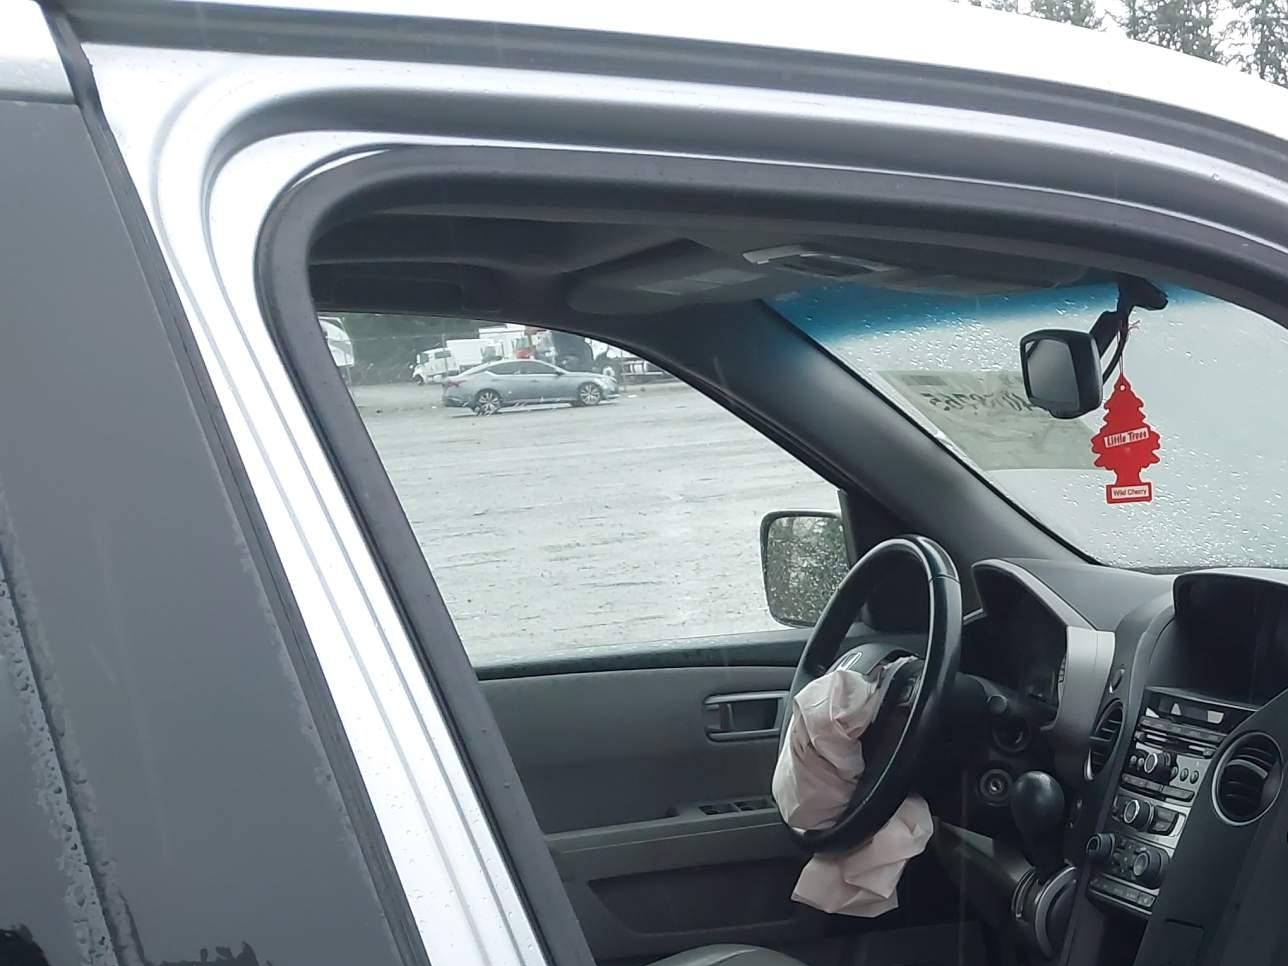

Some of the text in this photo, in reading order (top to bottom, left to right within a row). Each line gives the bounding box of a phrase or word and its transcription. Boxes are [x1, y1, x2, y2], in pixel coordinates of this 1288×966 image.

[1107, 430, 1147, 446] Little Trees
[1113, 488, 1147, 497] Wild Cherry
